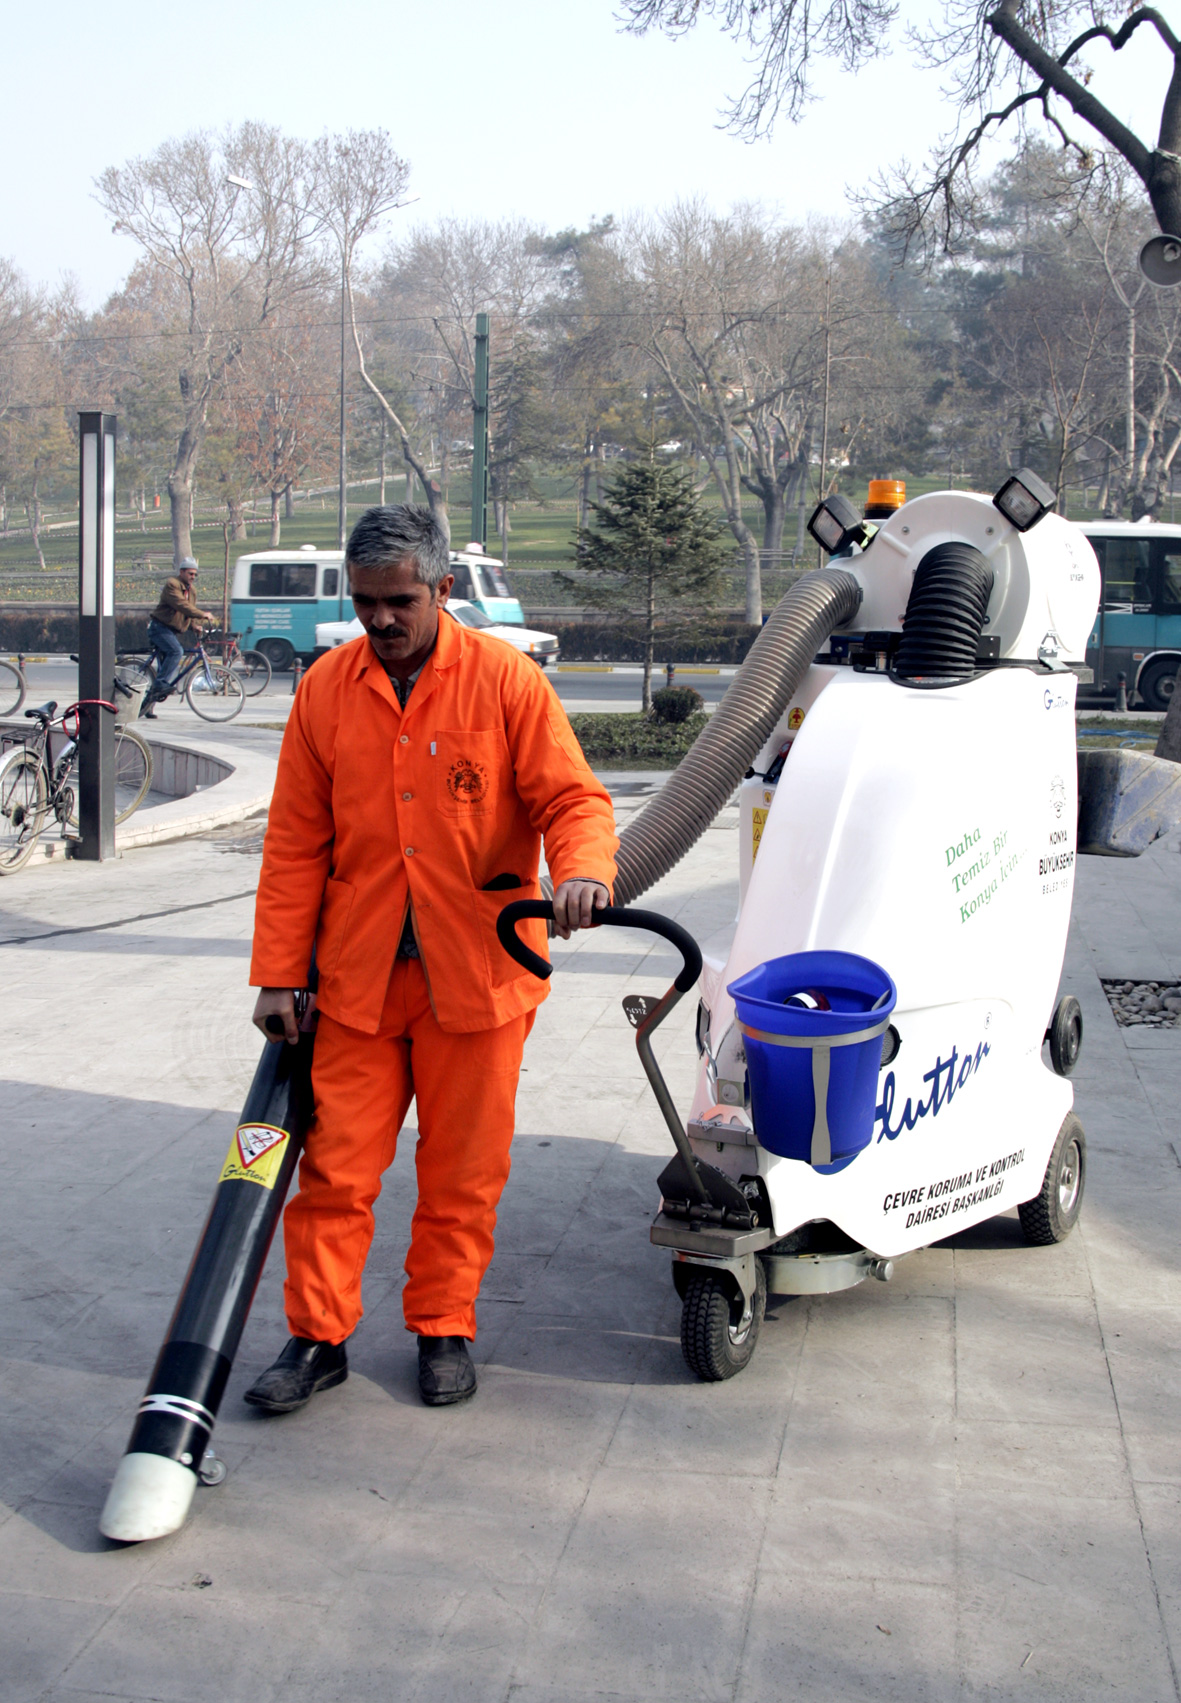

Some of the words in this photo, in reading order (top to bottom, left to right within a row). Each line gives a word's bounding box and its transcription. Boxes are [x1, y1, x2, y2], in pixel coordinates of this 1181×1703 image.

[450, 760, 485, 774] KONYA
[945, 828, 981, 867] Daha
[1049, 830, 1068, 845] KONYA
[952, 851, 991, 894] Temiz
[993, 830, 1008, 856] Bir
[959, 878, 998, 924] Konya
[223, 1164, 266, 1182] Glutton
[883, 1186, 926, 1216] ÇEVRE
[927, 1171, 973, 1204] KORUMA
[976, 1165, 988, 1185] VE
[989, 1148, 1026, 1178] KONTROL
[905, 1196, 952, 1229] DAİRESİ
